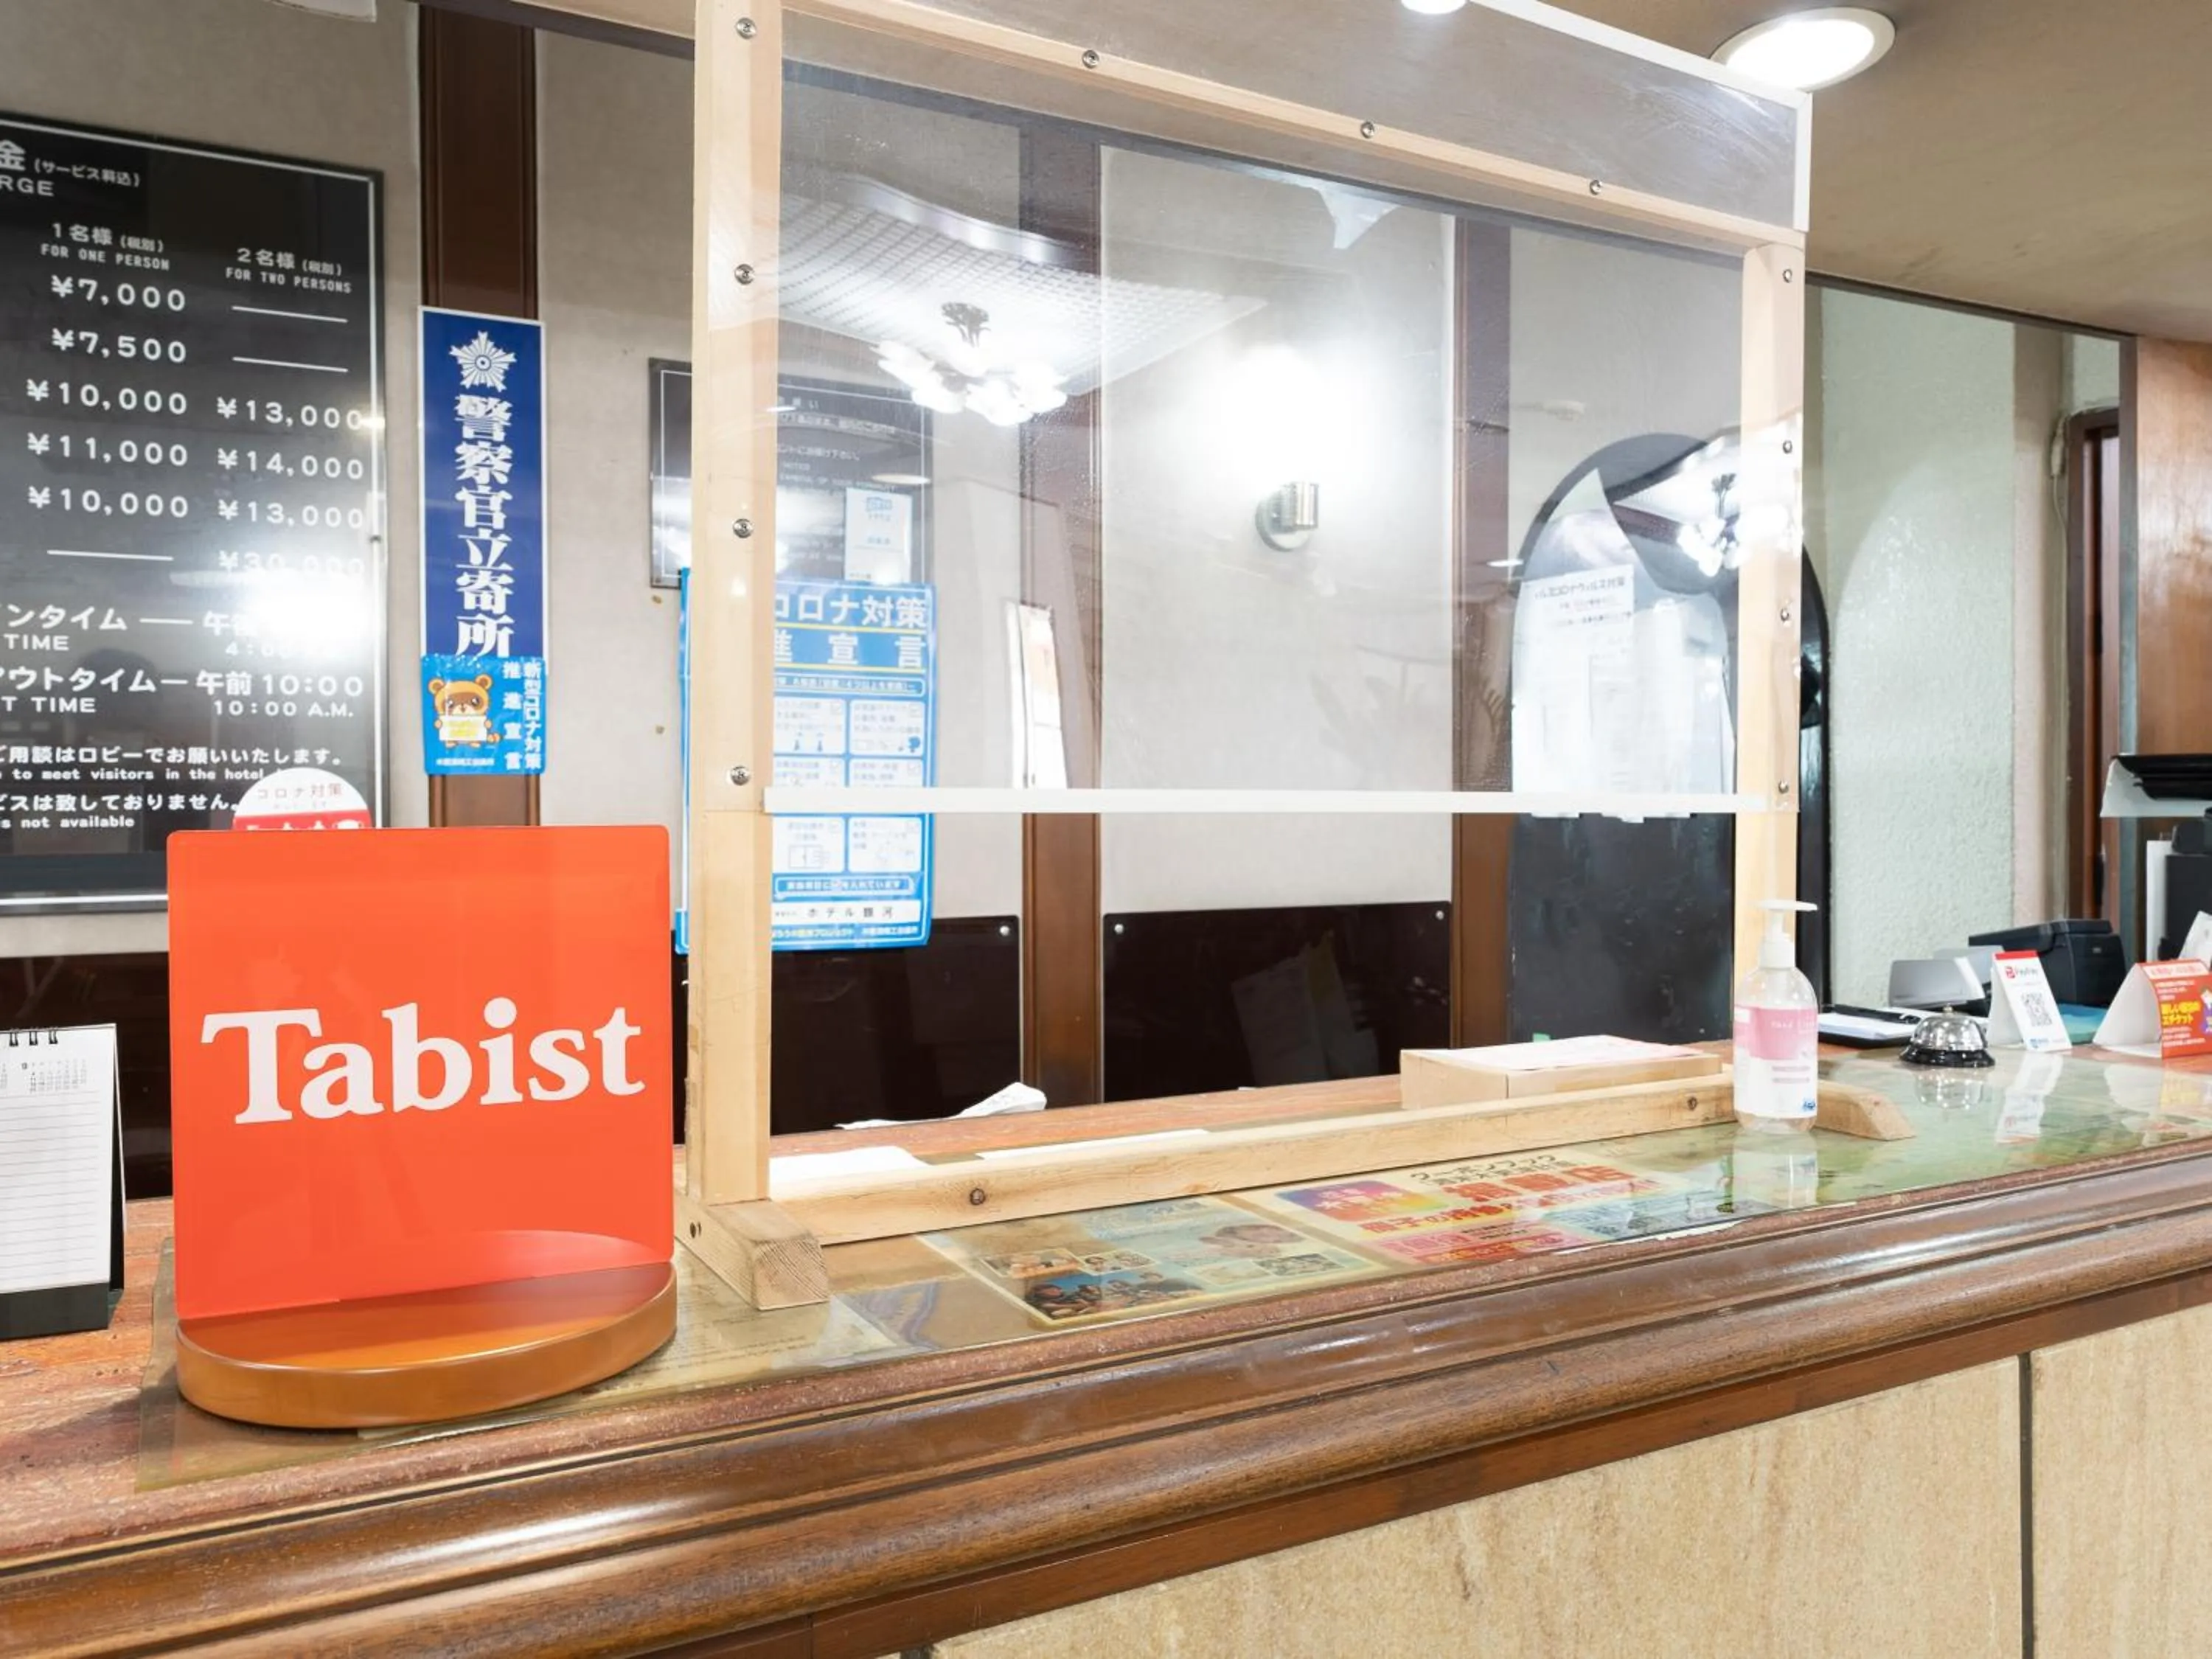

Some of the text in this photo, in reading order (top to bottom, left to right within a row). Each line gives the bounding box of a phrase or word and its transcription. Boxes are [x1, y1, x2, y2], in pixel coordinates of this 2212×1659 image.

[41, 243, 170, 271] FOR ONE PERSON
[52, 275, 186, 311] ¥7,000
[226, 267, 352, 294] FOR TWO PERSONS
[52, 328, 186, 362] ¥7,500
[27, 379, 187, 414] ¥10,000
[217, 397, 363, 430] ¥13,000
[27, 432, 188, 466] ¥11,000
[218, 448, 364, 480] ¥14,000
[28, 486, 189, 518] ¥10,000
[219, 498, 364, 529] ¥13,000
[454, 394, 515, 658] 警察官立寄所
[219, 549, 365, 573] ¥30000
[0, 603, 128, 630] ンタイム
[772, 594, 926, 627] コロナ対策
[4, 633, 70, 651] TIME
[0, 665, 157, 692] ウトタイム
[30, 697, 97, 713] TIME
[214, 700, 354, 718] 10:00 A.M.
[12, 768, 264, 781] to meet visitors in the hotel
[21, 817, 51, 828] not
[59, 815, 136, 830] available
[201, 997, 646, 1125] Tabist
